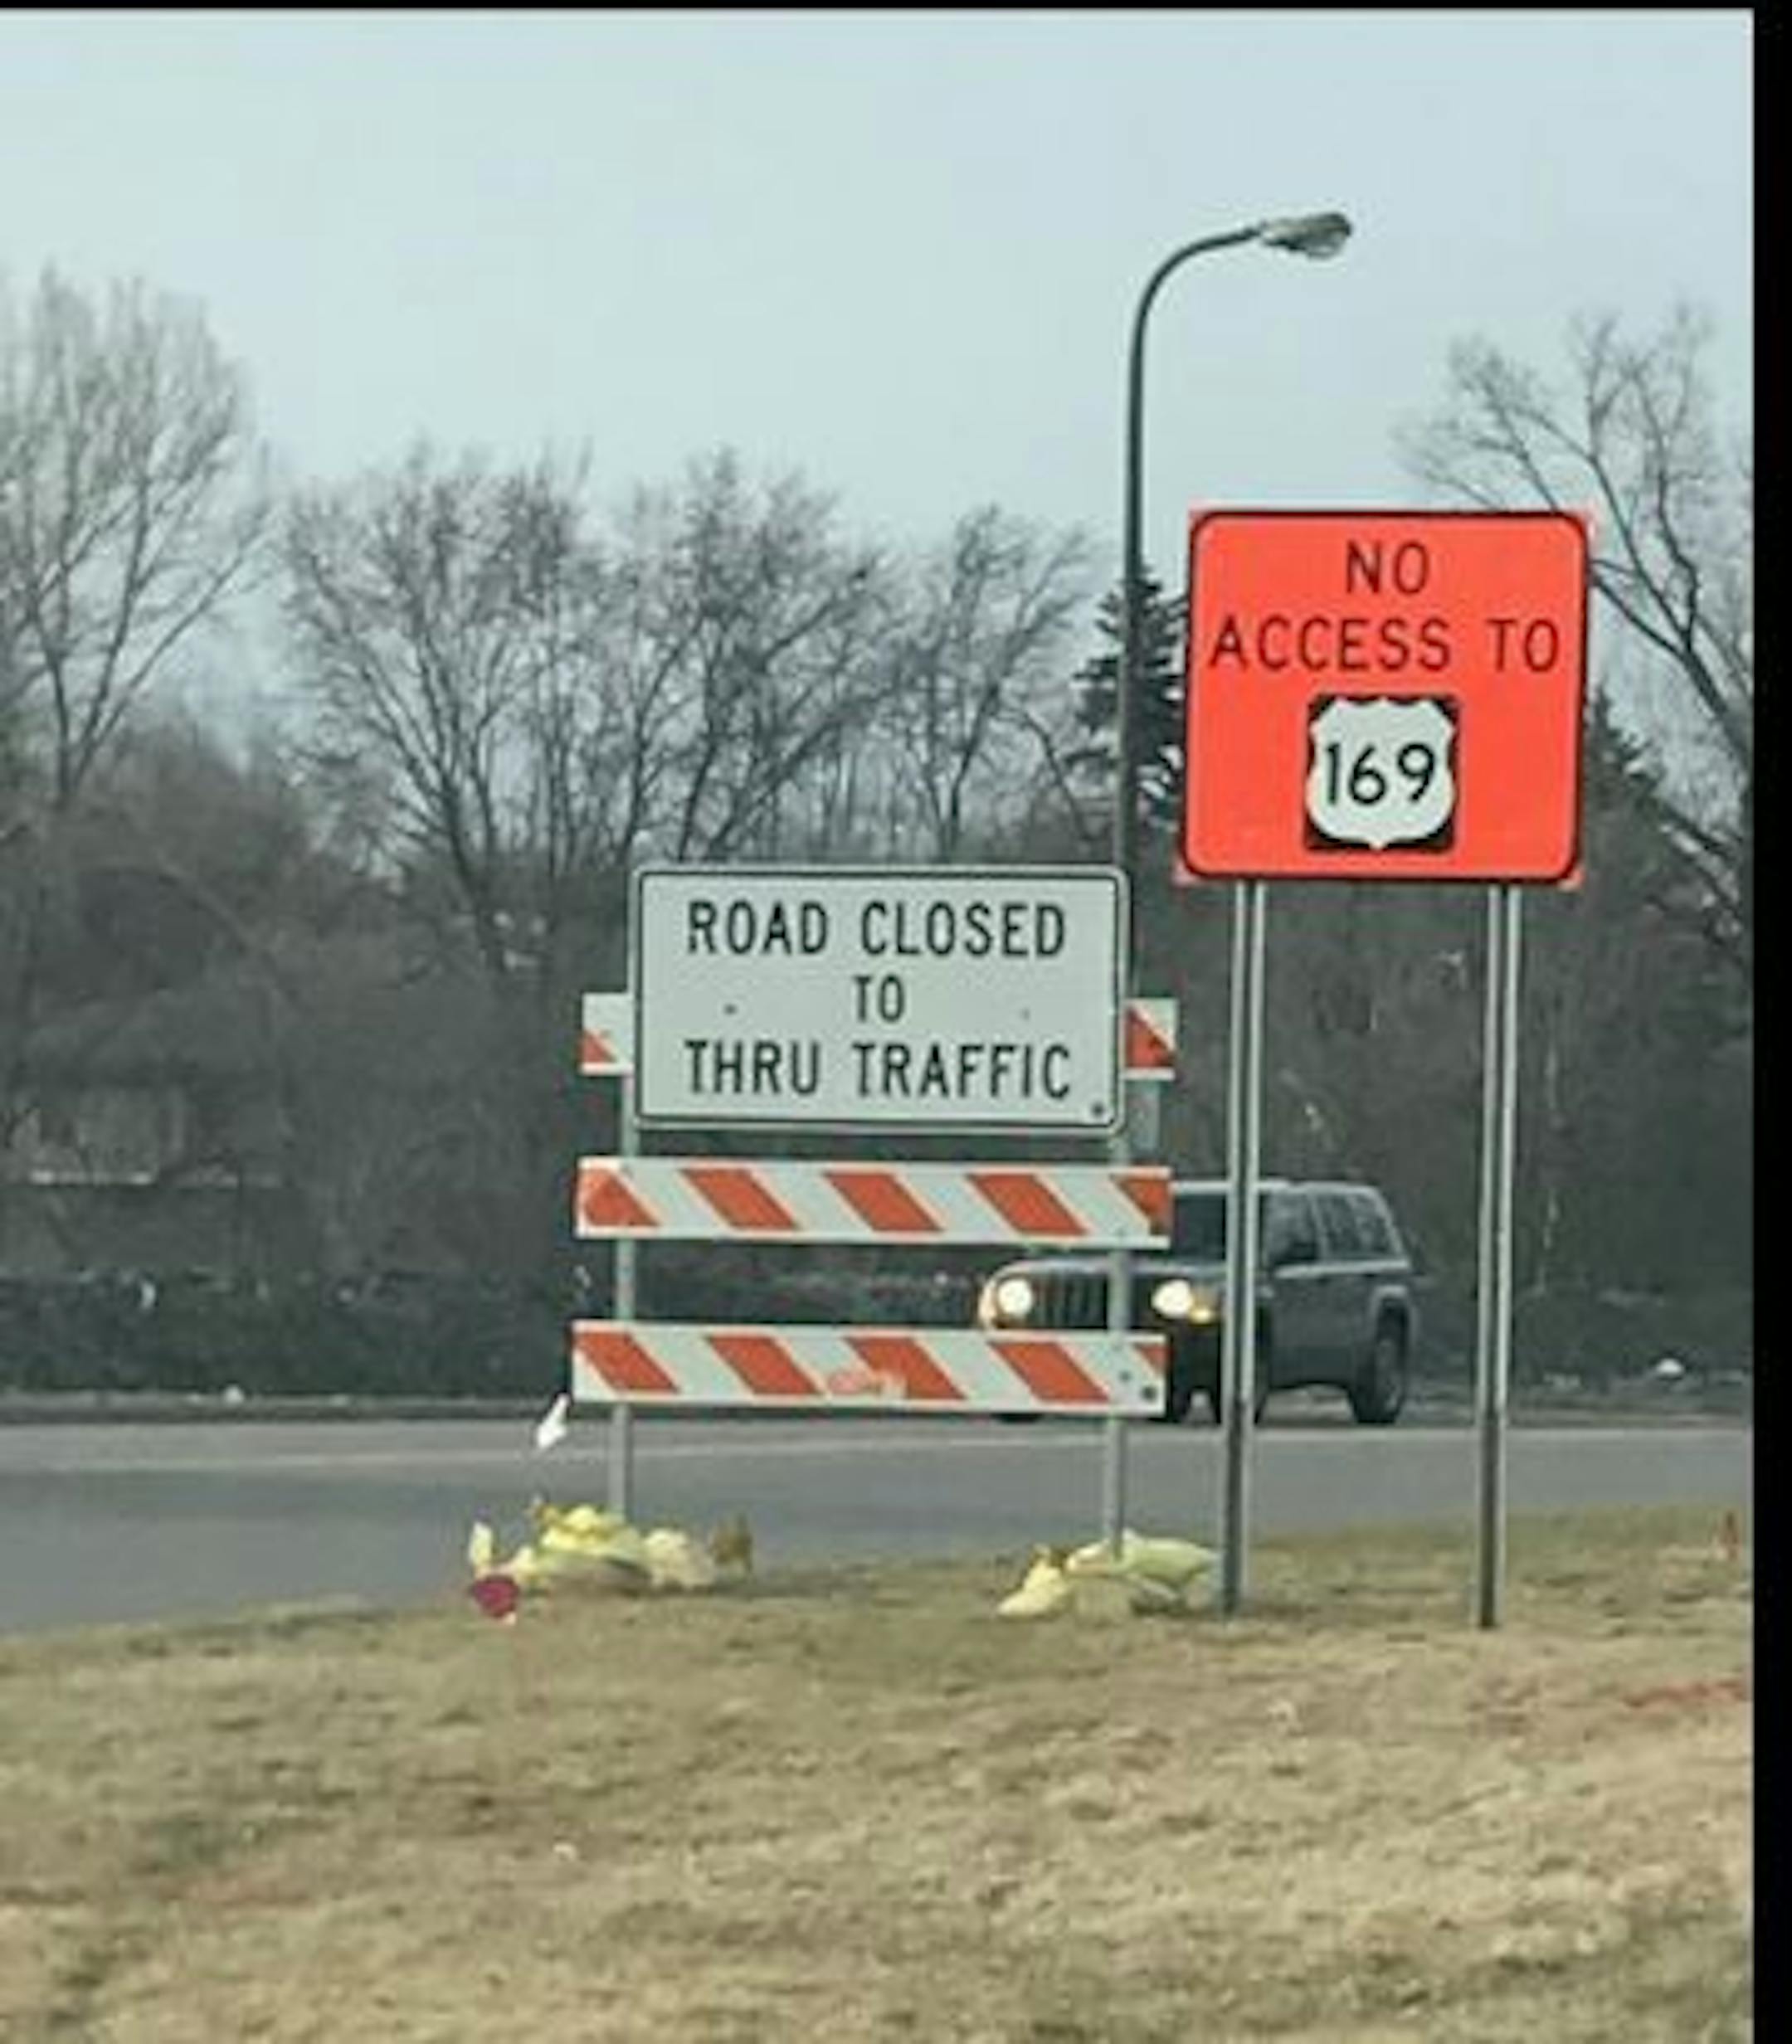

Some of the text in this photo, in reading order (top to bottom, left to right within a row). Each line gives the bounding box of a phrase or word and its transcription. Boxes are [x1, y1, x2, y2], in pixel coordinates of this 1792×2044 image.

[1346, 540, 1429, 595] NO
[1210, 614, 1560, 674] ACCESS TO
[1326, 742, 1436, 805] 169
[687, 899, 1066, 957] ROAD CLOSED
[854, 974, 906, 1024] TO
[684, 1039, 1071, 1100] THRU TRAFFIC
